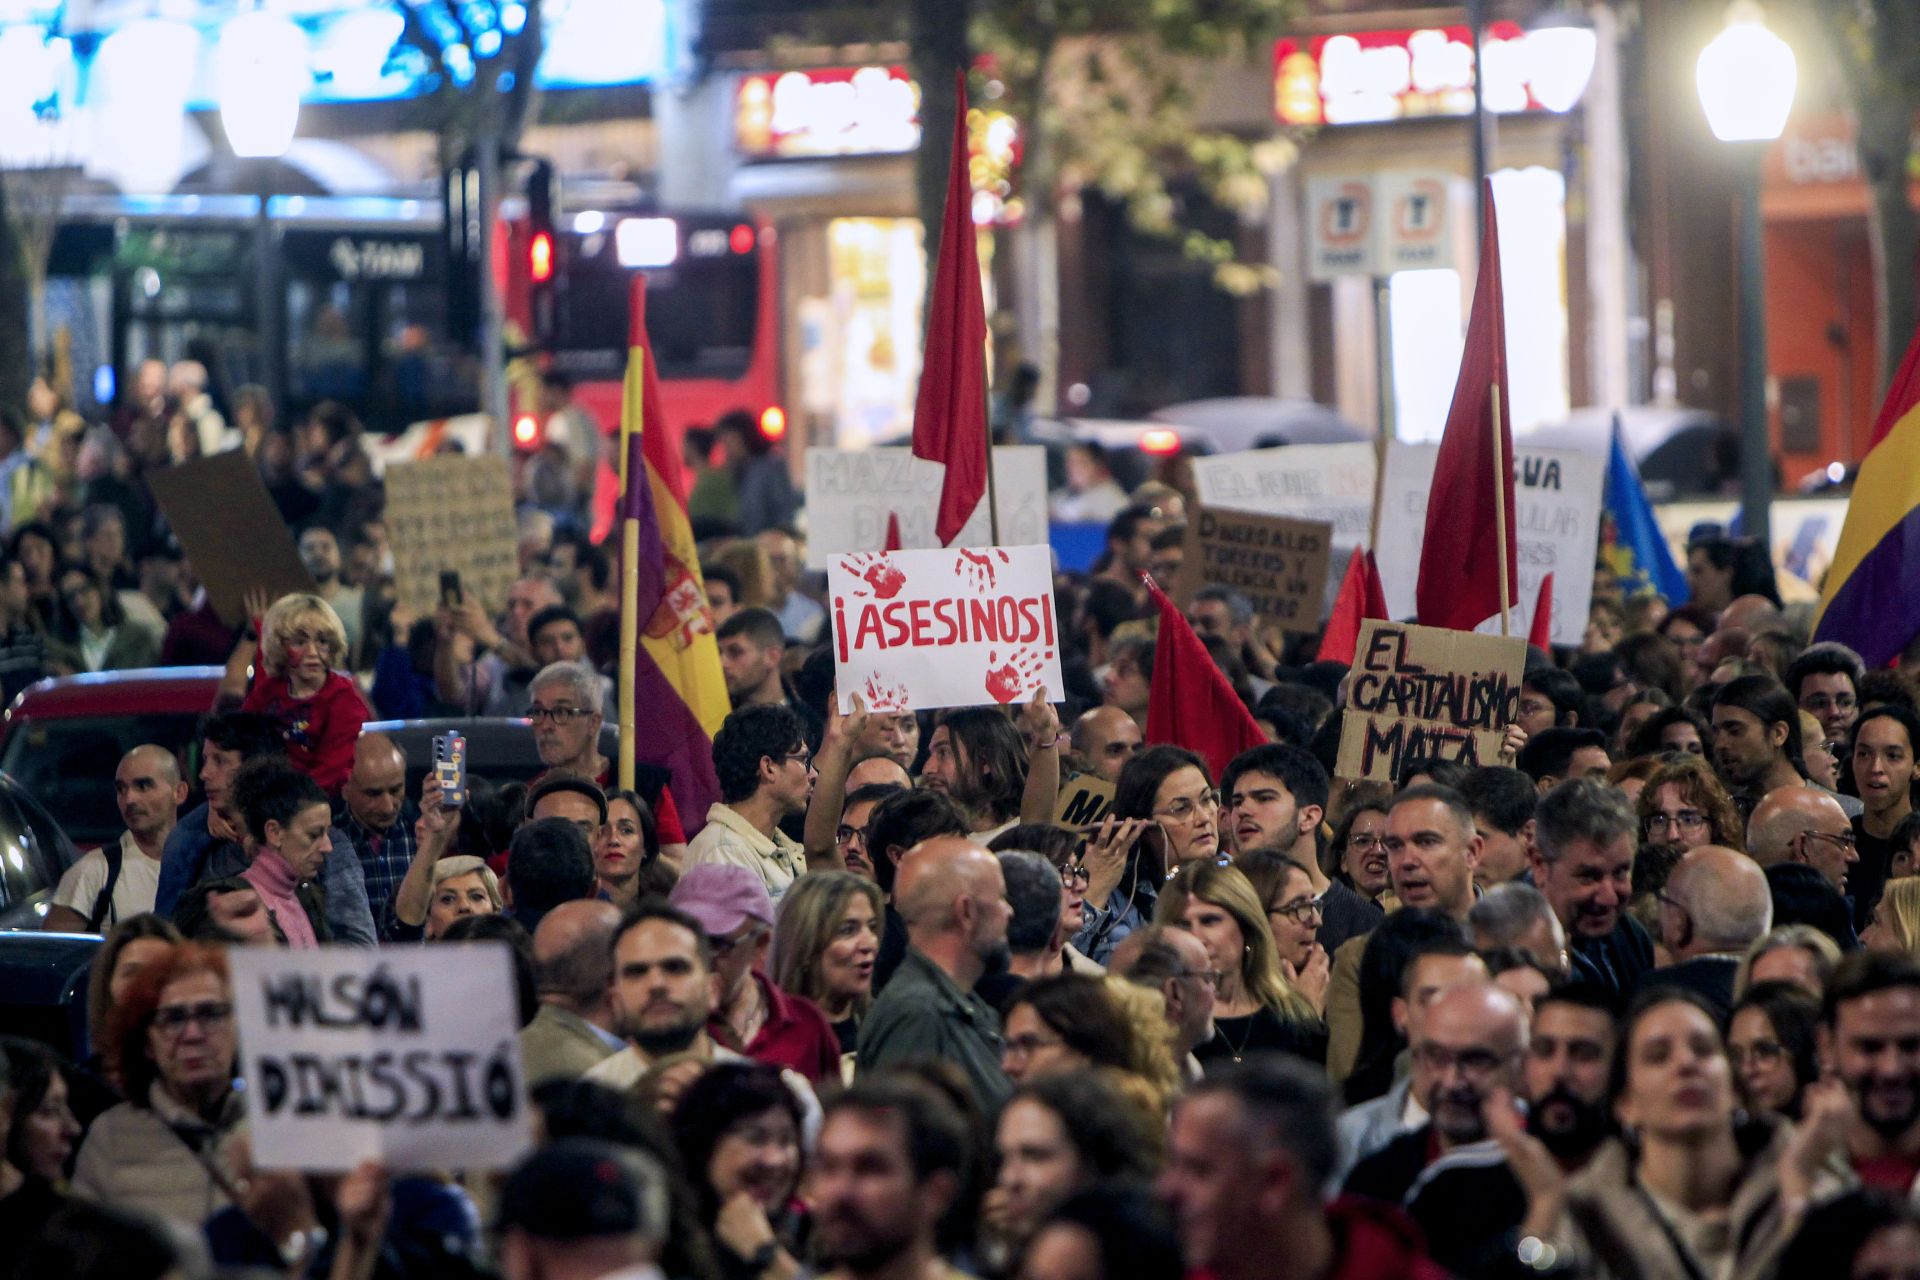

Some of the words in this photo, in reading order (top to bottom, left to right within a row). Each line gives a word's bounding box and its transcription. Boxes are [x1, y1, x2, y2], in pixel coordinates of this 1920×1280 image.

[835, 593, 1055, 663] ¡ASESINOS!
[1364, 628, 1427, 674] EL
[1361, 717, 1480, 782] MATA
